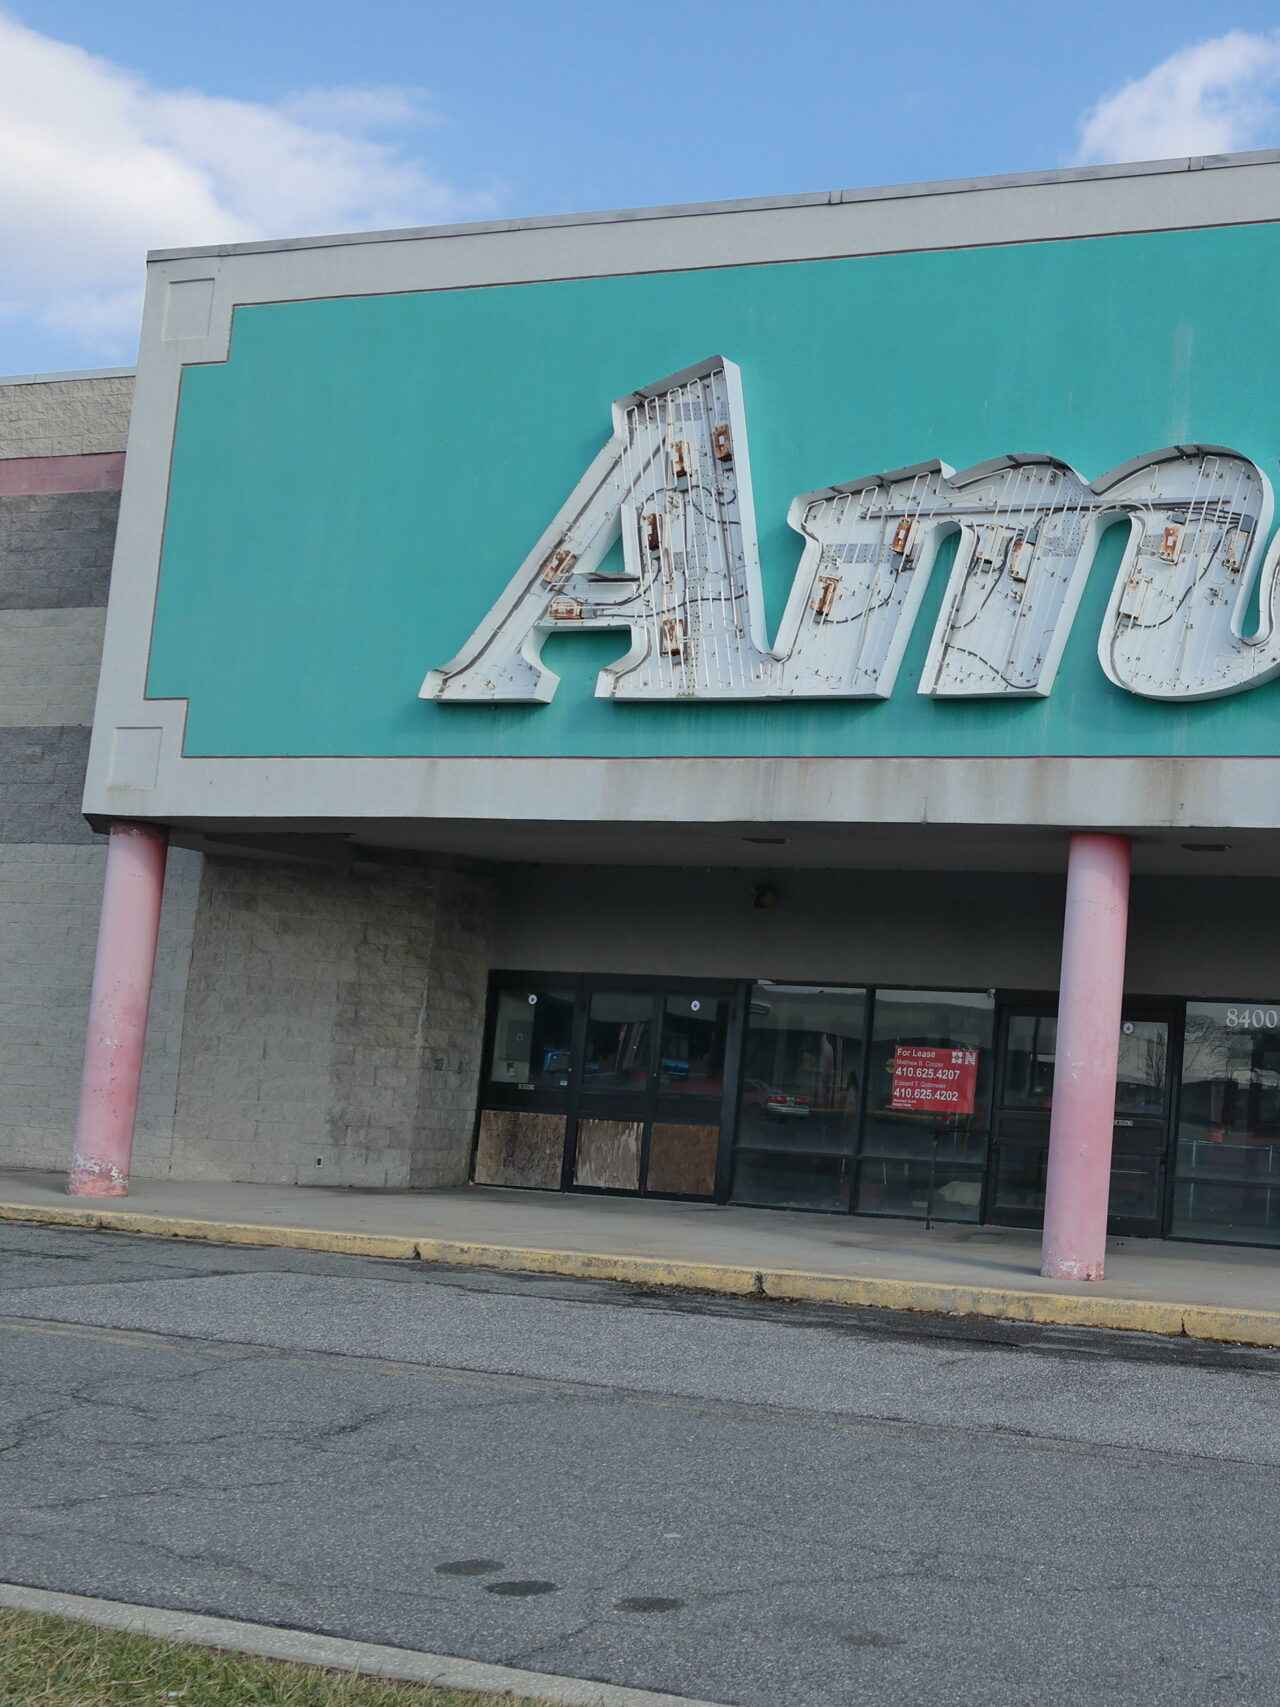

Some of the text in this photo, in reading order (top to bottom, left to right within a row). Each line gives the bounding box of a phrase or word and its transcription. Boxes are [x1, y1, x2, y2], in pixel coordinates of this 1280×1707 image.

[1226, 1008, 1278, 1028] 8400
[897, 1048, 936, 1058] For Lease
[896, 1067, 960, 1080] 410.625.4207
[894, 1088, 959, 1101] 410.625.4202
